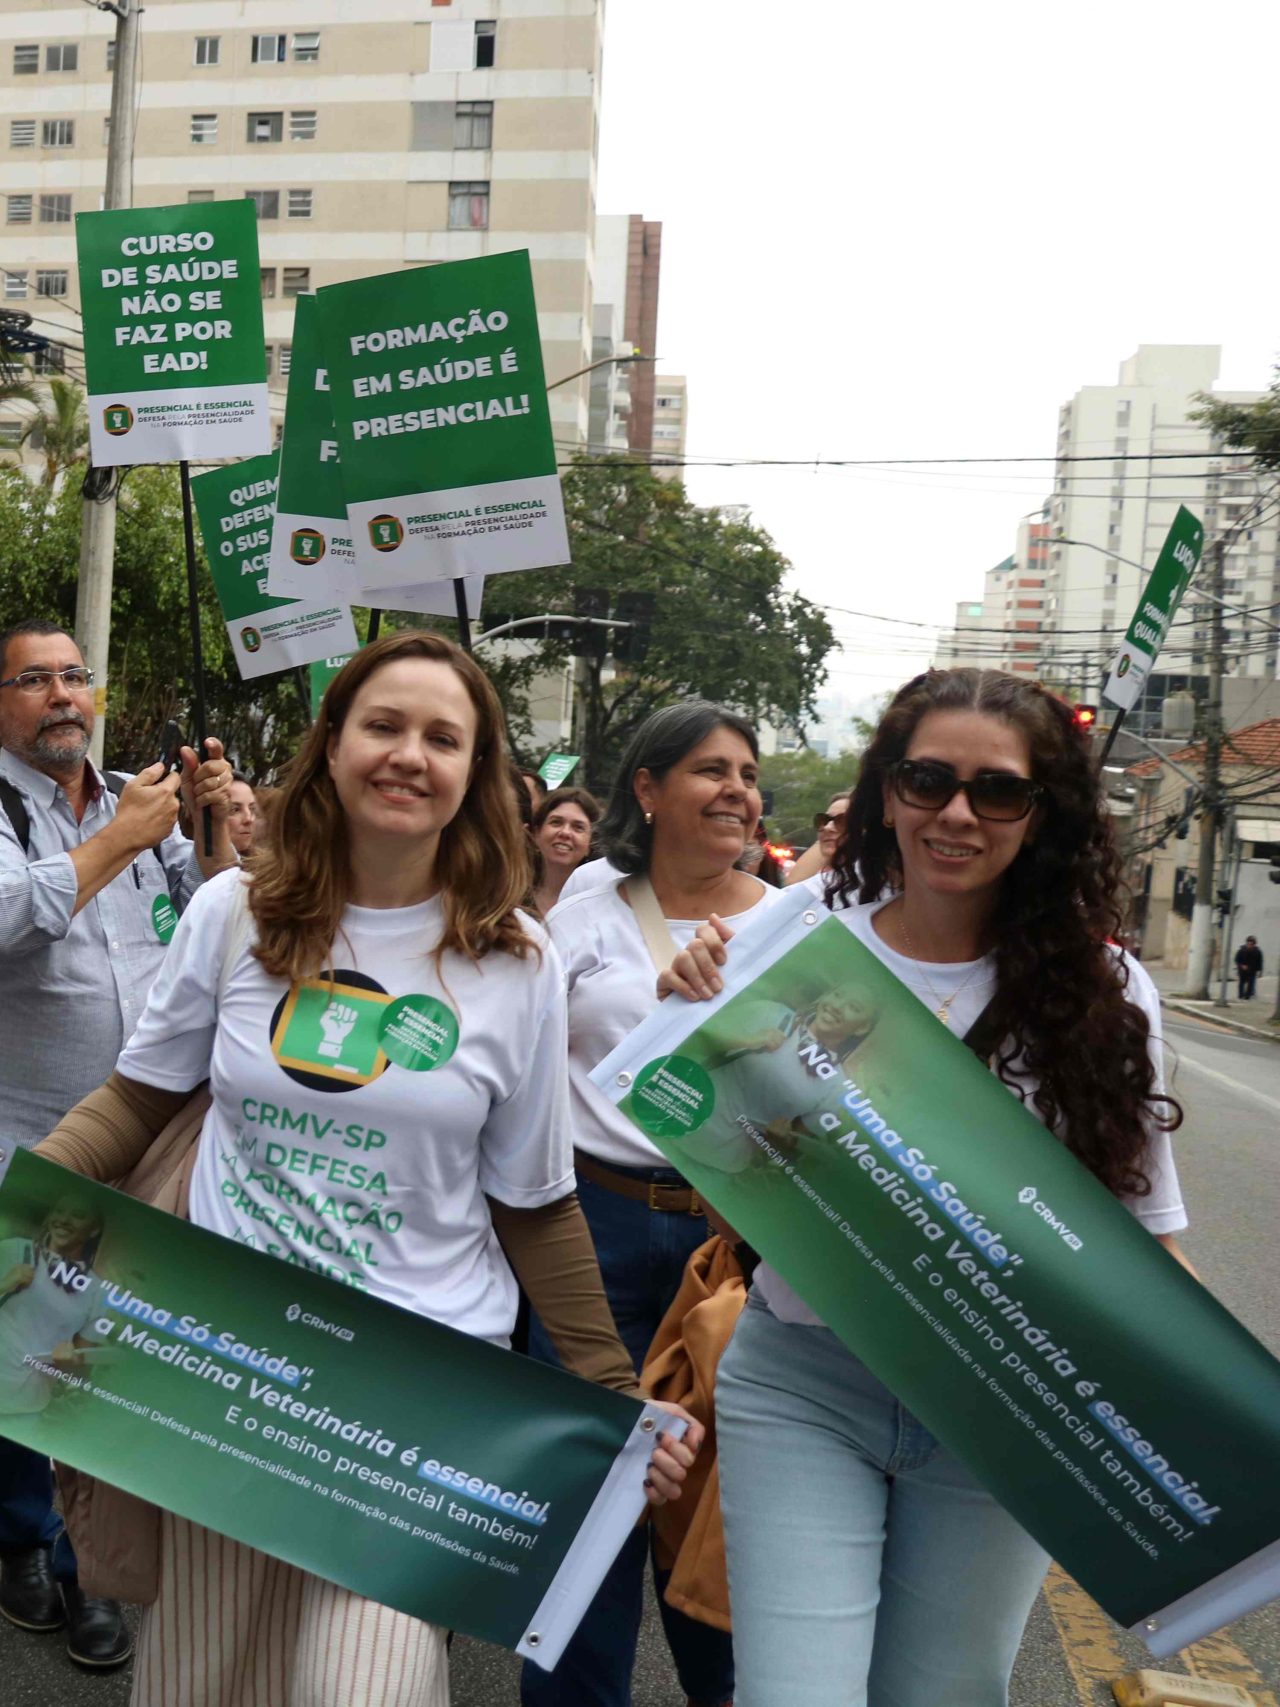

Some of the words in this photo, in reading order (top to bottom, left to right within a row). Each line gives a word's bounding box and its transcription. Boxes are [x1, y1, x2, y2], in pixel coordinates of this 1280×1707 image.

[121, 232, 214, 256] CURSO
[101, 267, 139, 288] DE
[145, 257, 239, 284] SAÚDE
[121, 289, 182, 316] NÃO
[188, 290, 222, 311] SE
[115, 324, 168, 346] FAZ
[175, 320, 232, 341] POR
[350, 308, 508, 356] FORMAÇÃO
[143, 351, 208, 374] EAD!
[353, 373, 392, 398] EM
[399, 357, 493, 390] SAÚDE
[500, 347, 519, 373] É
[137, 404, 194, 415] PRESENCIAL
[196, 402, 202, 410] É
[204, 400, 255, 410] ESSENCIAL
[138, 415, 166, 423] DEFESA
[187, 409, 255, 419] PRESENCIALIDADE
[162, 419, 204, 428] FORMAÇÃO
[218, 416, 244, 424] SAÚDE
[352, 394, 530, 440] PRESENCIAL!
[220, 501, 277, 533] DEFEN
[406, 509, 473, 525] PRESENCIAL
[475, 505, 482, 516] É
[484, 499, 546, 515] ESSENCIAL
[409, 525, 440, 535] DEFESA
[465, 510, 548, 527] PRESENCIALIDADE
[220, 541, 233, 557] O
[237, 528, 269, 553] SUS
[437, 526, 485, 540] FORMAÇÃO
[488, 525, 501, 533] EM
[503, 520, 534, 531] SAÚDE
[402, 1005, 448, 1038] PRESENCIAL
[403, 1017, 444, 1046] ESSENCIAL
[657, 1067, 704, 1102] PRESENCIAL
[658, 1079, 700, 1110] ESSENCIAL
[242, 1098, 386, 1152] CRMV-SP
[799, 1043, 839, 1081] Na
[898, 1146, 939, 1181] Só
[264, 1142, 389, 1197] DEFESA
[51, 1262, 90, 1292] Na
[174, 1315, 210, 1343] Só
[819, 1112, 842, 1132] a
[837, 1131, 946, 1241] Medicina
[944, 1240, 1078, 1378] Veterinária
[1075, 1380, 1102, 1398] é
[1095, 1400, 1221, 1526] essencial.
[735, 1113, 787, 1168] Presencial
[785, 1165, 795, 1175] é
[792, 1172, 840, 1223] essencial!
[838, 1221, 874, 1259] Defesa
[871, 1258, 896, 1285] pela
[893, 1280, 974, 1365] presencialidade
[972, 1363, 986, 1380] na
[985, 1377, 1036, 1431] formação
[1035, 1429, 1056, 1450] das
[1052, 1450, 1108, 1507] profissões
[1107, 1504, 1122, 1523] da
[1122, 1520, 1160, 1561] Saúde.
[912, 1253, 932, 1273] E
[928, 1272, 943, 1287] o
[943, 1287, 1005, 1351] ensino
[1001, 1351, 1105, 1451] presencial
[1099, 1450, 1194, 1543] também!
[94, 1315, 113, 1335] a
[117, 1323, 242, 1392] Medicina
[248, 1377, 397, 1457] Veterinária
[400, 1446, 421, 1467] é
[422, 1459, 551, 1524] essencial.
[23, 1353, 82, 1388] Presencial
[83, 1379, 92, 1391] é
[93, 1385, 150, 1418] essencial!
[151, 1410, 190, 1436] Defesa
[192, 1426, 217, 1448] pela
[219, 1439, 312, 1488] presencialidade
[314, 1481, 328, 1496] na
[331, 1487, 387, 1522] formação
[389, 1514, 410, 1532] das
[411, 1523, 471, 1557] profissões
[472, 1549, 487, 1564] da
[488, 1555, 520, 1576] Saúde.
[225, 1405, 239, 1425] E
[244, 1417, 257, 1431] o
[262, 1423, 331, 1463] ensino
[333, 1456, 444, 1511] presencial
[448, 1500, 539, 1550] também!
